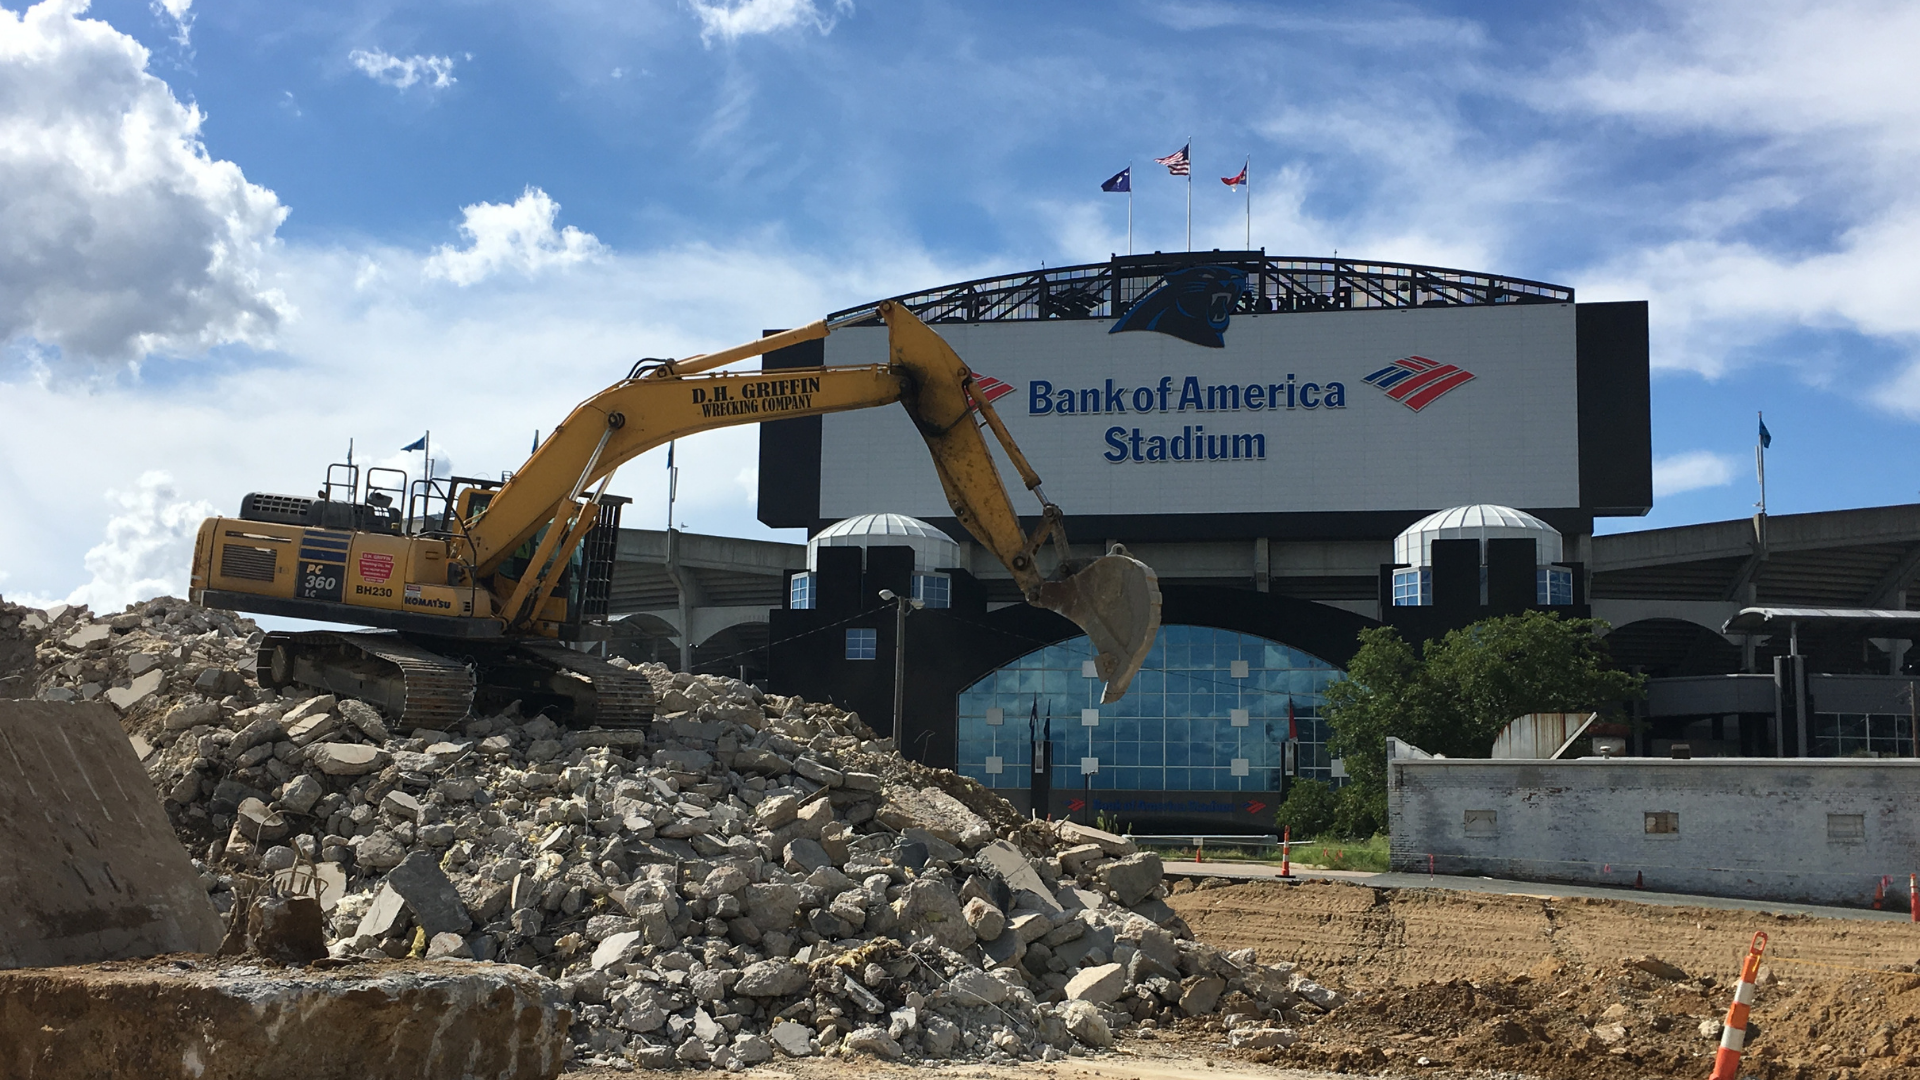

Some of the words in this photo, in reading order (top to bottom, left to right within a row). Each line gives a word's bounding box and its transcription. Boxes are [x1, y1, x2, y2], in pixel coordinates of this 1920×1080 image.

[692, 385, 734, 404] D.H.
[742, 377, 820, 399] GRIFFIN
[1028, 378, 1127, 416] Bank
[1132, 375, 1173, 413] of
[1177, 373, 1346, 411] America
[702, 399, 758, 418] WRECKING
[762, 394, 812, 412] COMPANY
[1103, 425, 1266, 463] Stadium
[306, 564, 323, 575] PC
[305, 575, 336, 590] 360
[304, 589, 316, 598] LC
[356, 585, 393, 597] BH230
[404, 596, 451, 609] KOMATSU
[1092, 799, 1121, 811] Bank
[1123, 800, 1136, 811] of
[1137, 800, 1186, 812] America
[1187, 801, 1236, 812] Stadium
